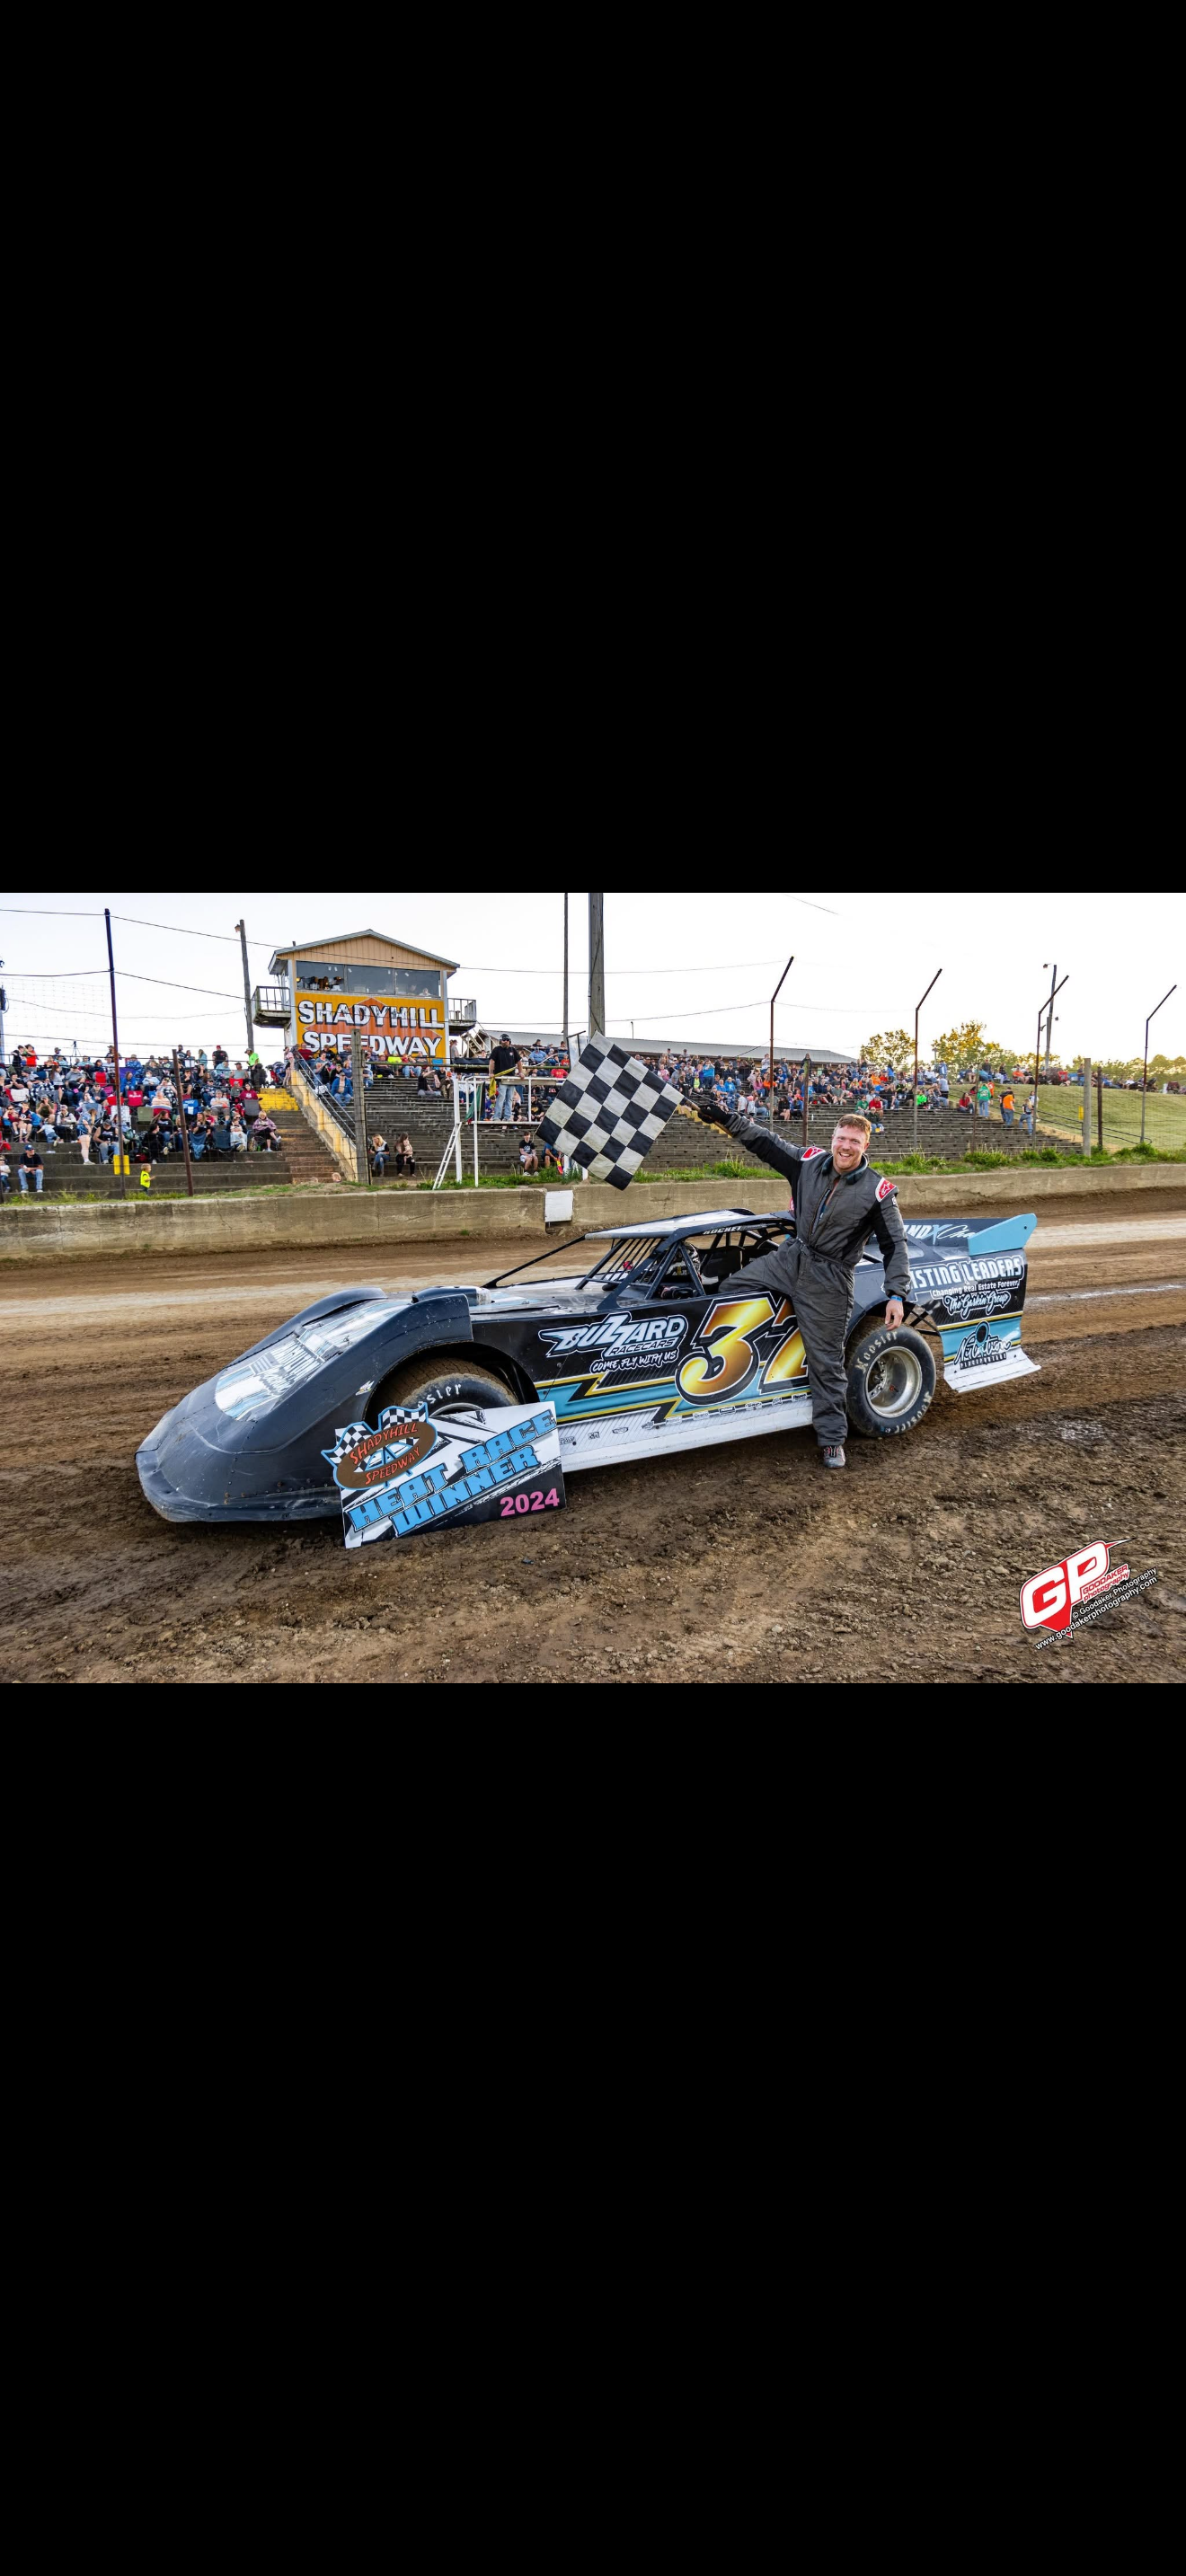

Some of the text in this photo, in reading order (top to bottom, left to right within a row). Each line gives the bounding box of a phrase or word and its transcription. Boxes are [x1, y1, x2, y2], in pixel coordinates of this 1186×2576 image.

[298, 1000, 445, 1028] SHADYHILL
[908, 1264, 962, 1290] ISTING
[961, 1257, 1022, 1282] LEADERS
[932, 1286, 963, 1297] Changing
[963, 1284, 977, 1293] Real
[978, 1282, 996, 1292] Estate
[944, 1295, 961, 1311] The
[541, 1314, 686, 1354] BUZZARD
[608, 1339, 674, 1356] RACECARS
[593, 1350, 677, 1372] COME FLY WITH US
[854, 1330, 898, 1375] Hoosier
[417, 1383, 462, 1408] osier
[349, 1422, 419, 1465] SHADYHILL
[345, 1408, 558, 1533] HEAT RACE
[365, 1447, 421, 1486] SPEEDWAY
[388, 1444, 543, 1539] WINNER
[500, 1487, 560, 1517] 2024
